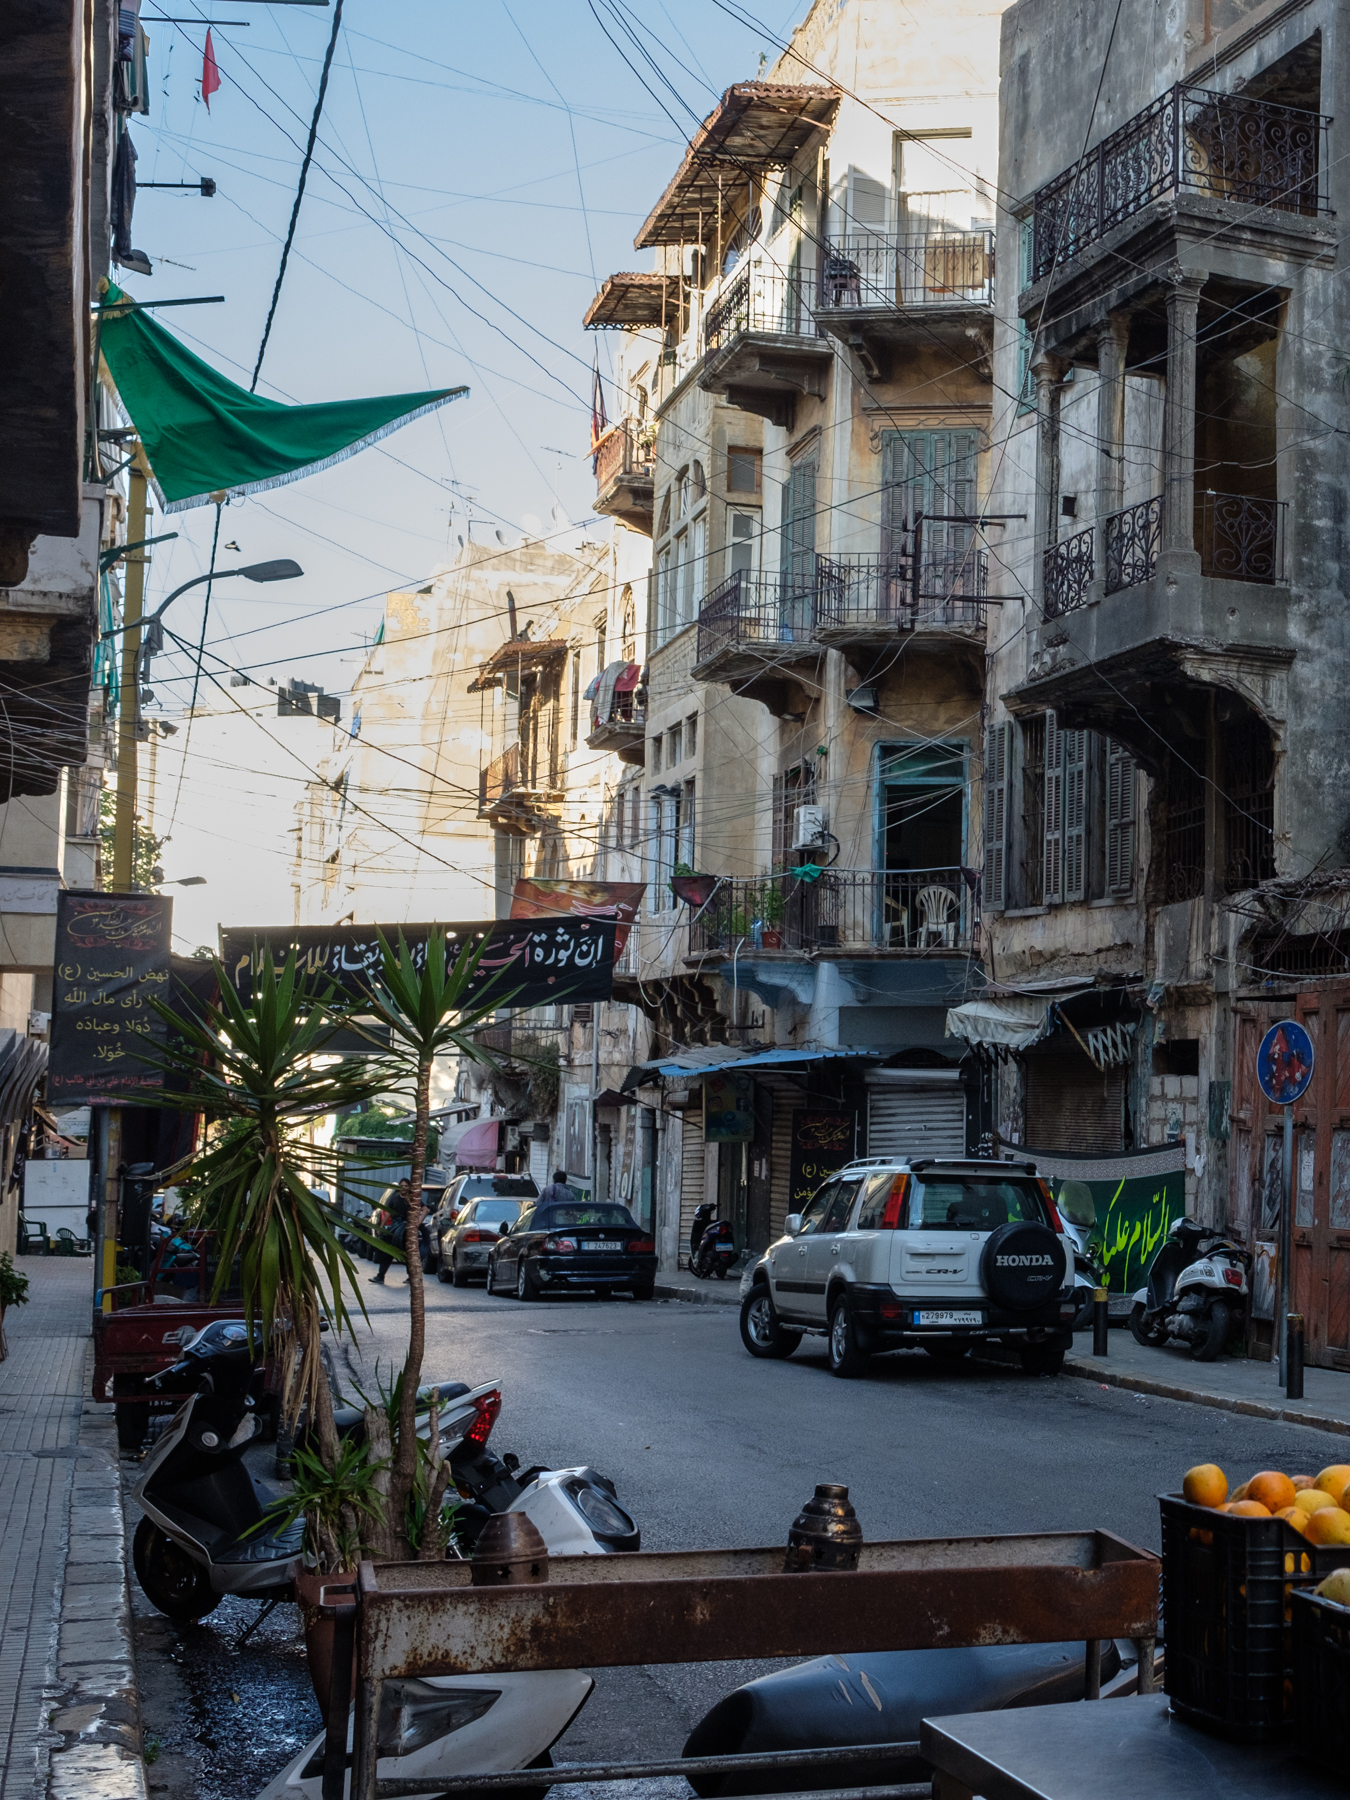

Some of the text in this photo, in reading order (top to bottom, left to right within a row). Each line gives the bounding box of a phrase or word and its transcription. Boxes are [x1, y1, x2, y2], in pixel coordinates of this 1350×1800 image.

[532, 926, 575, 968] ثورة
[57, 962, 170, 982] نهض الحسين (ع)
[120, 988, 143, 1008] رأى
[65, 1074, 84, 1086] طالب
[801, 1162, 817, 1178] (ع)
[995, 1254, 1054, 1267] HONDA
